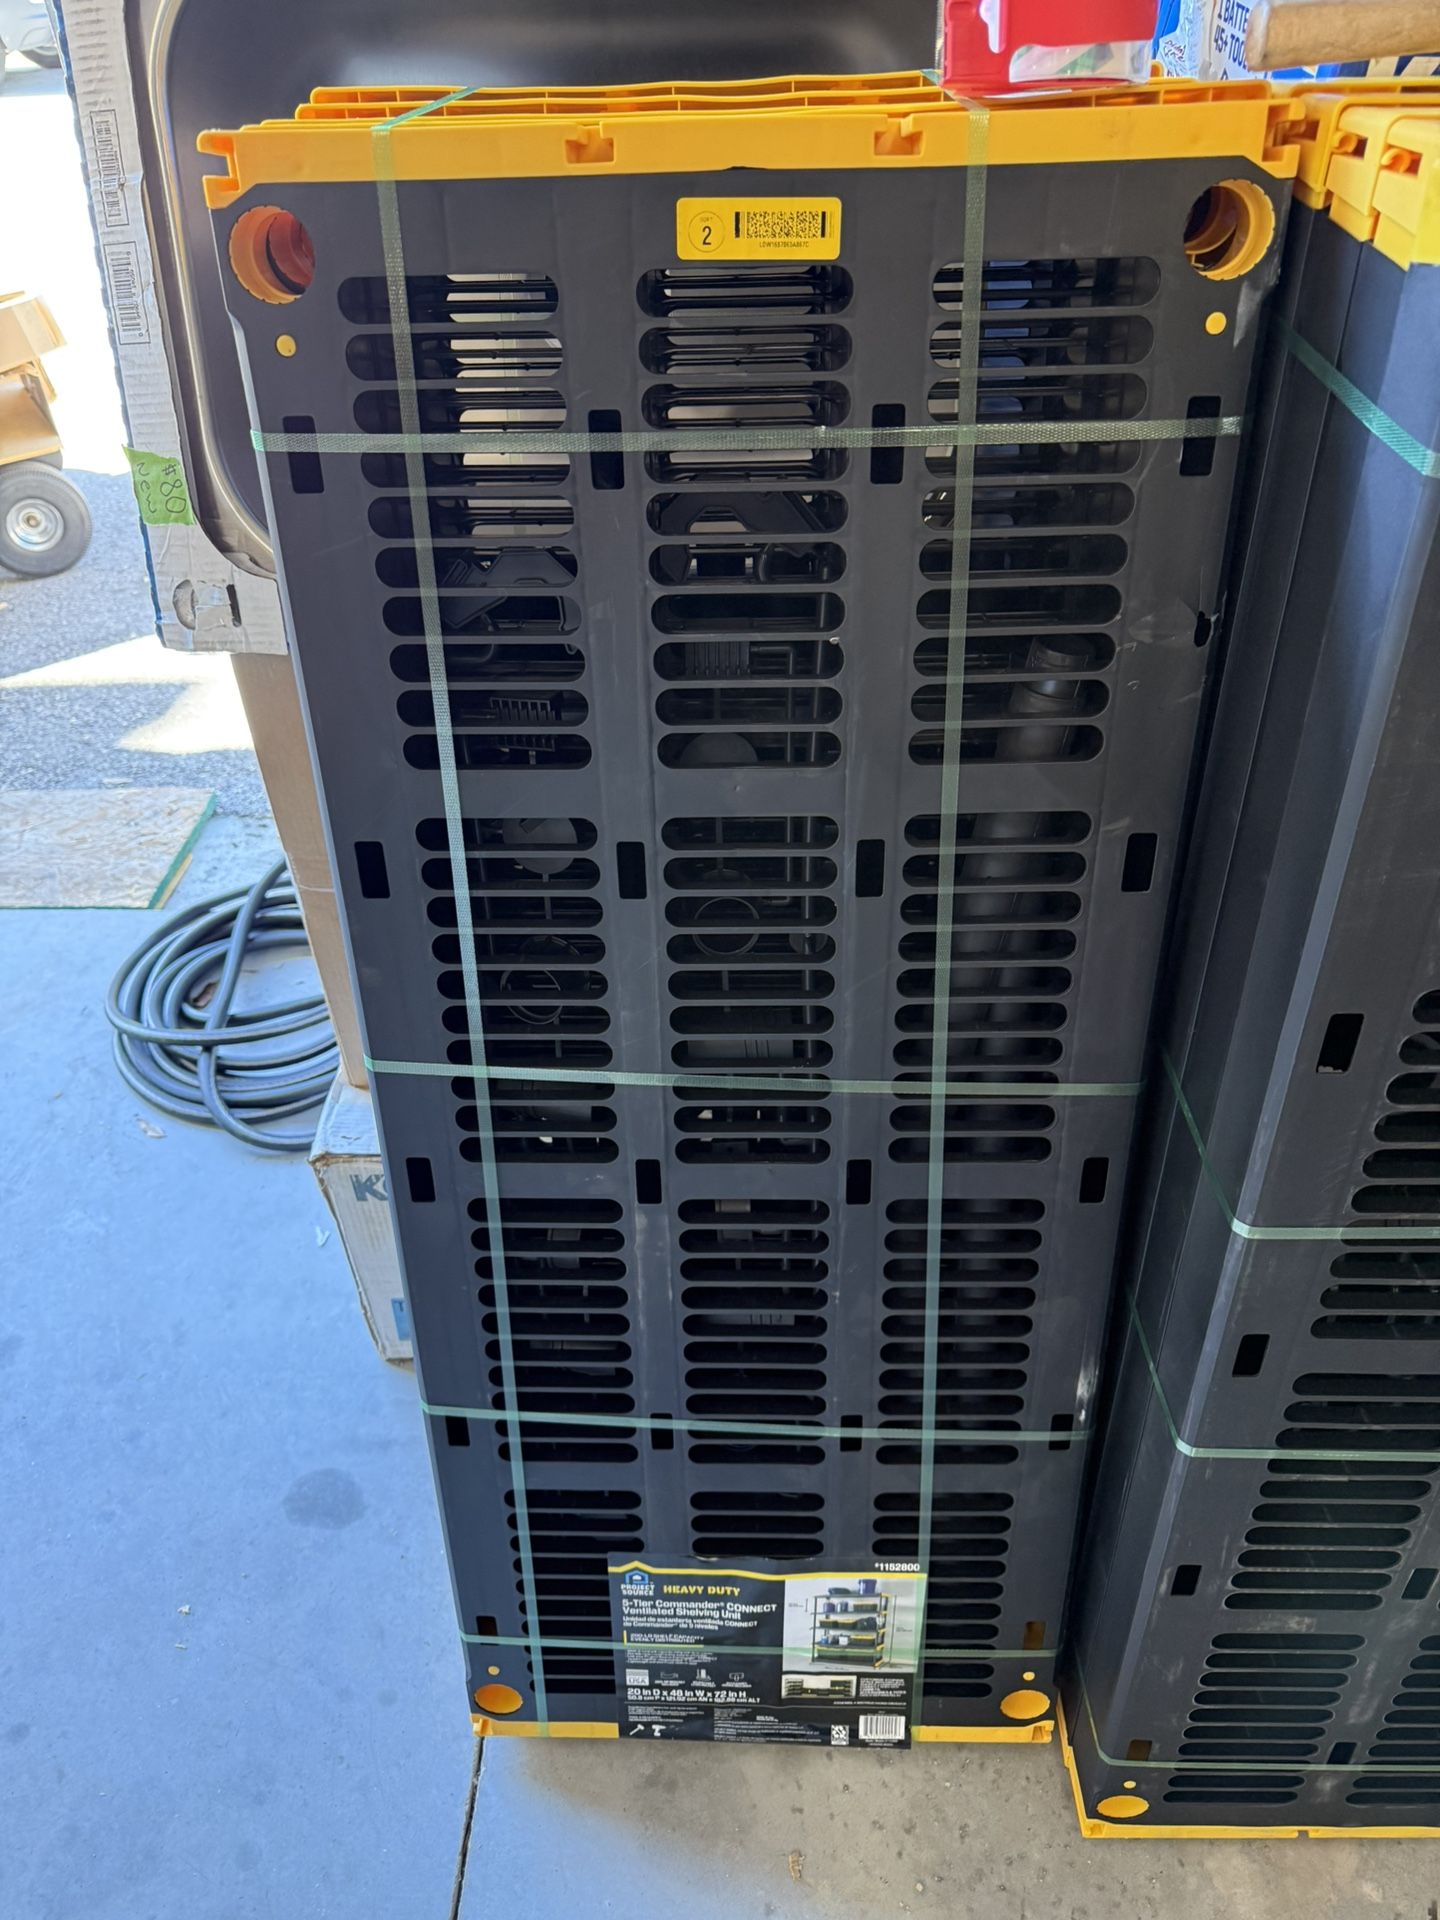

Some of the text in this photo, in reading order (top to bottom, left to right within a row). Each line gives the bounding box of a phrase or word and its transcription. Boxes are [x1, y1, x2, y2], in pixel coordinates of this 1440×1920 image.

[1223, 0, 1249, 33] BATTE
[1213, 24, 1249, 72] 45+ TOOL
[702, 225, 712, 246] 2
[349, 1174, 389, 1202] K
[663, 1585, 741, 1597] HEAVY DUTY
[622, 1599, 654, 1608] 5-Tier
[726, 1603, 777, 1613] CONNECT
[622, 1607, 742, 1620] Ventilated Shelving Unit
[724, 1620, 758, 1628] CONNECT
[627, 1688, 641, 1696] 20
[652, 1688, 661, 1696] D
[669, 1689, 683, 1697] 48
[714, 1690, 727, 1698] 72
[738, 1690, 747, 1698] H
